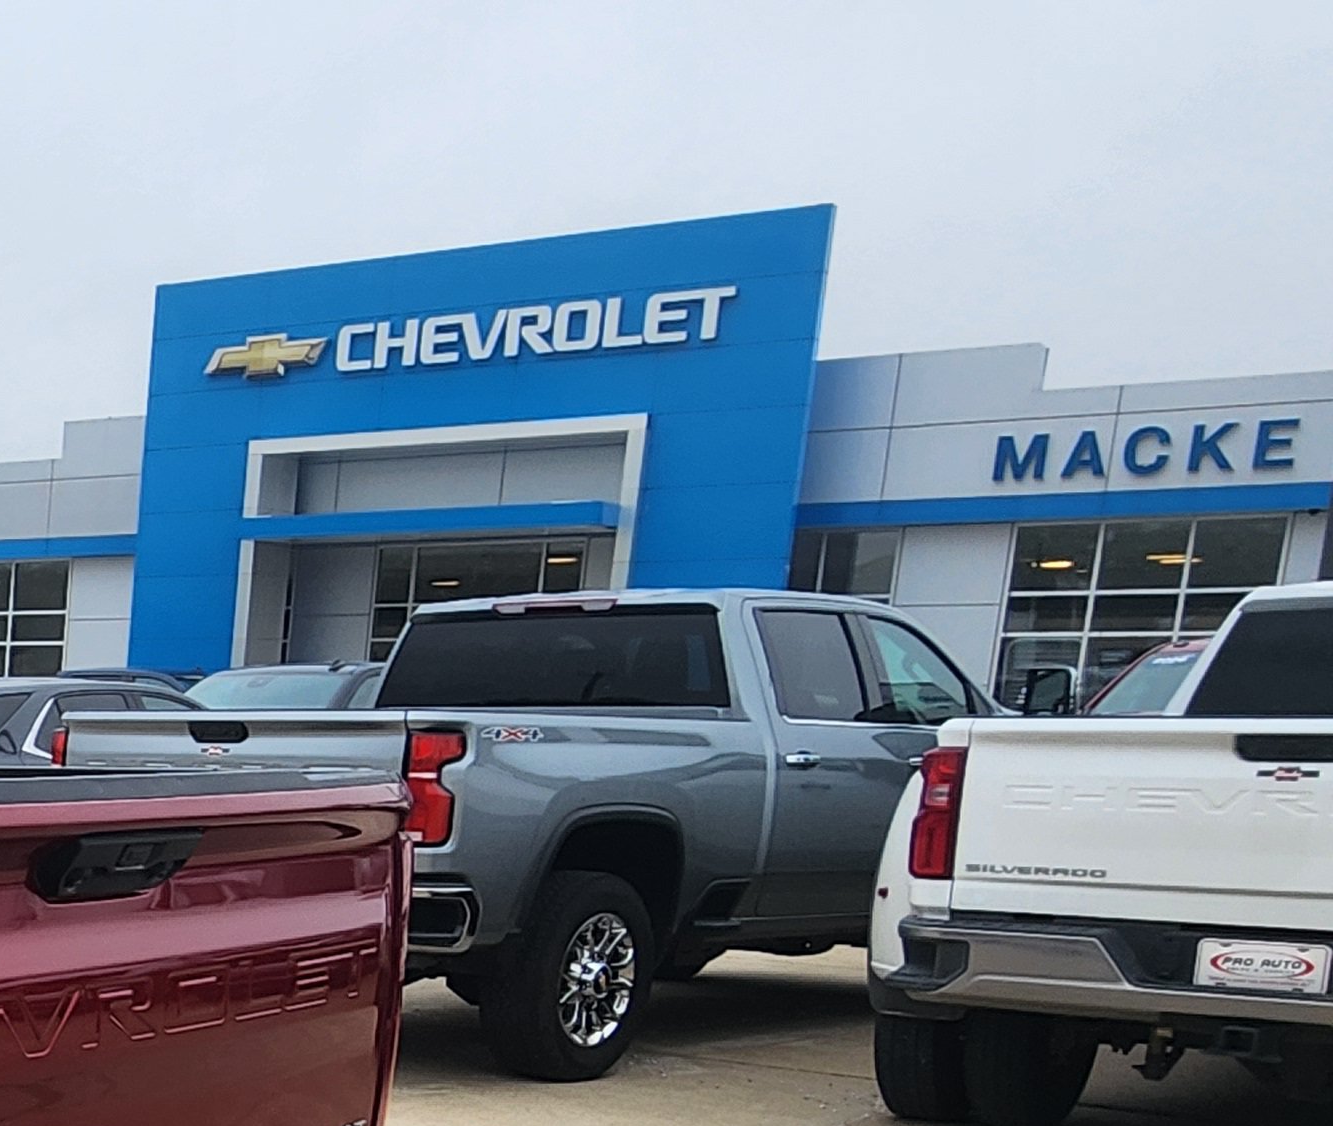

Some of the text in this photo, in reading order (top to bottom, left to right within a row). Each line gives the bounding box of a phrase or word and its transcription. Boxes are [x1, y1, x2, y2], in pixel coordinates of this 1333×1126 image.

[336, 285, 737, 372] CHEVROLET
[992, 418, 1300, 482] MACKE
[965, 863, 1107, 879] SILVERADO
[1220, 956, 1254, 967] PRO
[1260, 958, 1302, 970] AUTO
